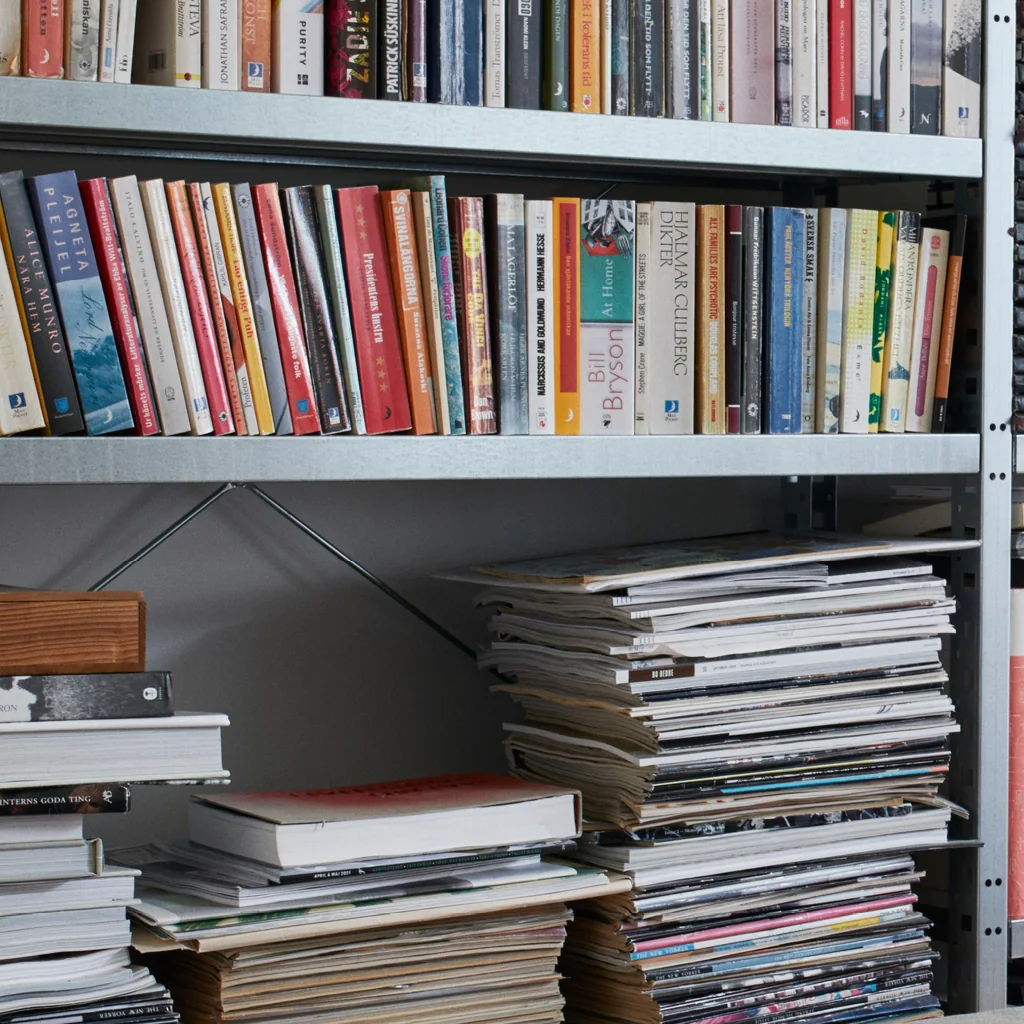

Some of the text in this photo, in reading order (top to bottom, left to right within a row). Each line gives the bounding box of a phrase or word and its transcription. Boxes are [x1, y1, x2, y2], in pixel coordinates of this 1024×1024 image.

[220, 36, 229, 84] JONATHAN
[299, 20, 309, 66] PURITY
[346, 10, 370, 83] ZADIE
[386, 46, 399, 94] PATRICK
[644, 24, 652, 63] TID SOM
[717, 45, 726, 77] Proust
[491, 71, 501, 100] Tomas
[582, 72, 592, 87] tid
[801, 94, 809, 122] PICADOR
[43, 187, 72, 276] PLEIJEL
[62, 194, 89, 272] AGNETA
[123, 190, 144, 263] ITALO CALVINO
[433, 186, 448, 251] Leonard Cohen
[659, 210, 673, 268] DIKTER
[708, 216, 719, 319] ALL FAMILIES ARE PSYCHOTIC
[804, 219, 815, 277] SVENSK SMAK
[16, 254, 41, 334] NÄRA HEM
[24, 228, 62, 355] ALICE MUNRO
[362, 251, 382, 311] Presidentens
[473, 291, 483, 310] DA
[601, 258, 613, 317] At Home
[672, 209, 689, 377] HJALMAR GULLBERG
[750, 280, 758, 340] WITTGENSTEIN
[370, 312, 386, 343] hustru
[413, 311, 422, 350] Susanna
[536, 232, 545, 395] NARCISSUS AND GOLDMUND HERMANN HESSE
[638, 252, 646, 394] Stephen Crane MAGGIE: GIRL THE STREETS
[238, 375, 252, 409] Profeten
[588, 352, 606, 383] Bill
[602, 328, 629, 411] Bryson
[40, 795, 91, 805] GODA TING
[649, 949, 662, 957] NEW
[98, 1005, 159, 1019] THE NEW YORKER
